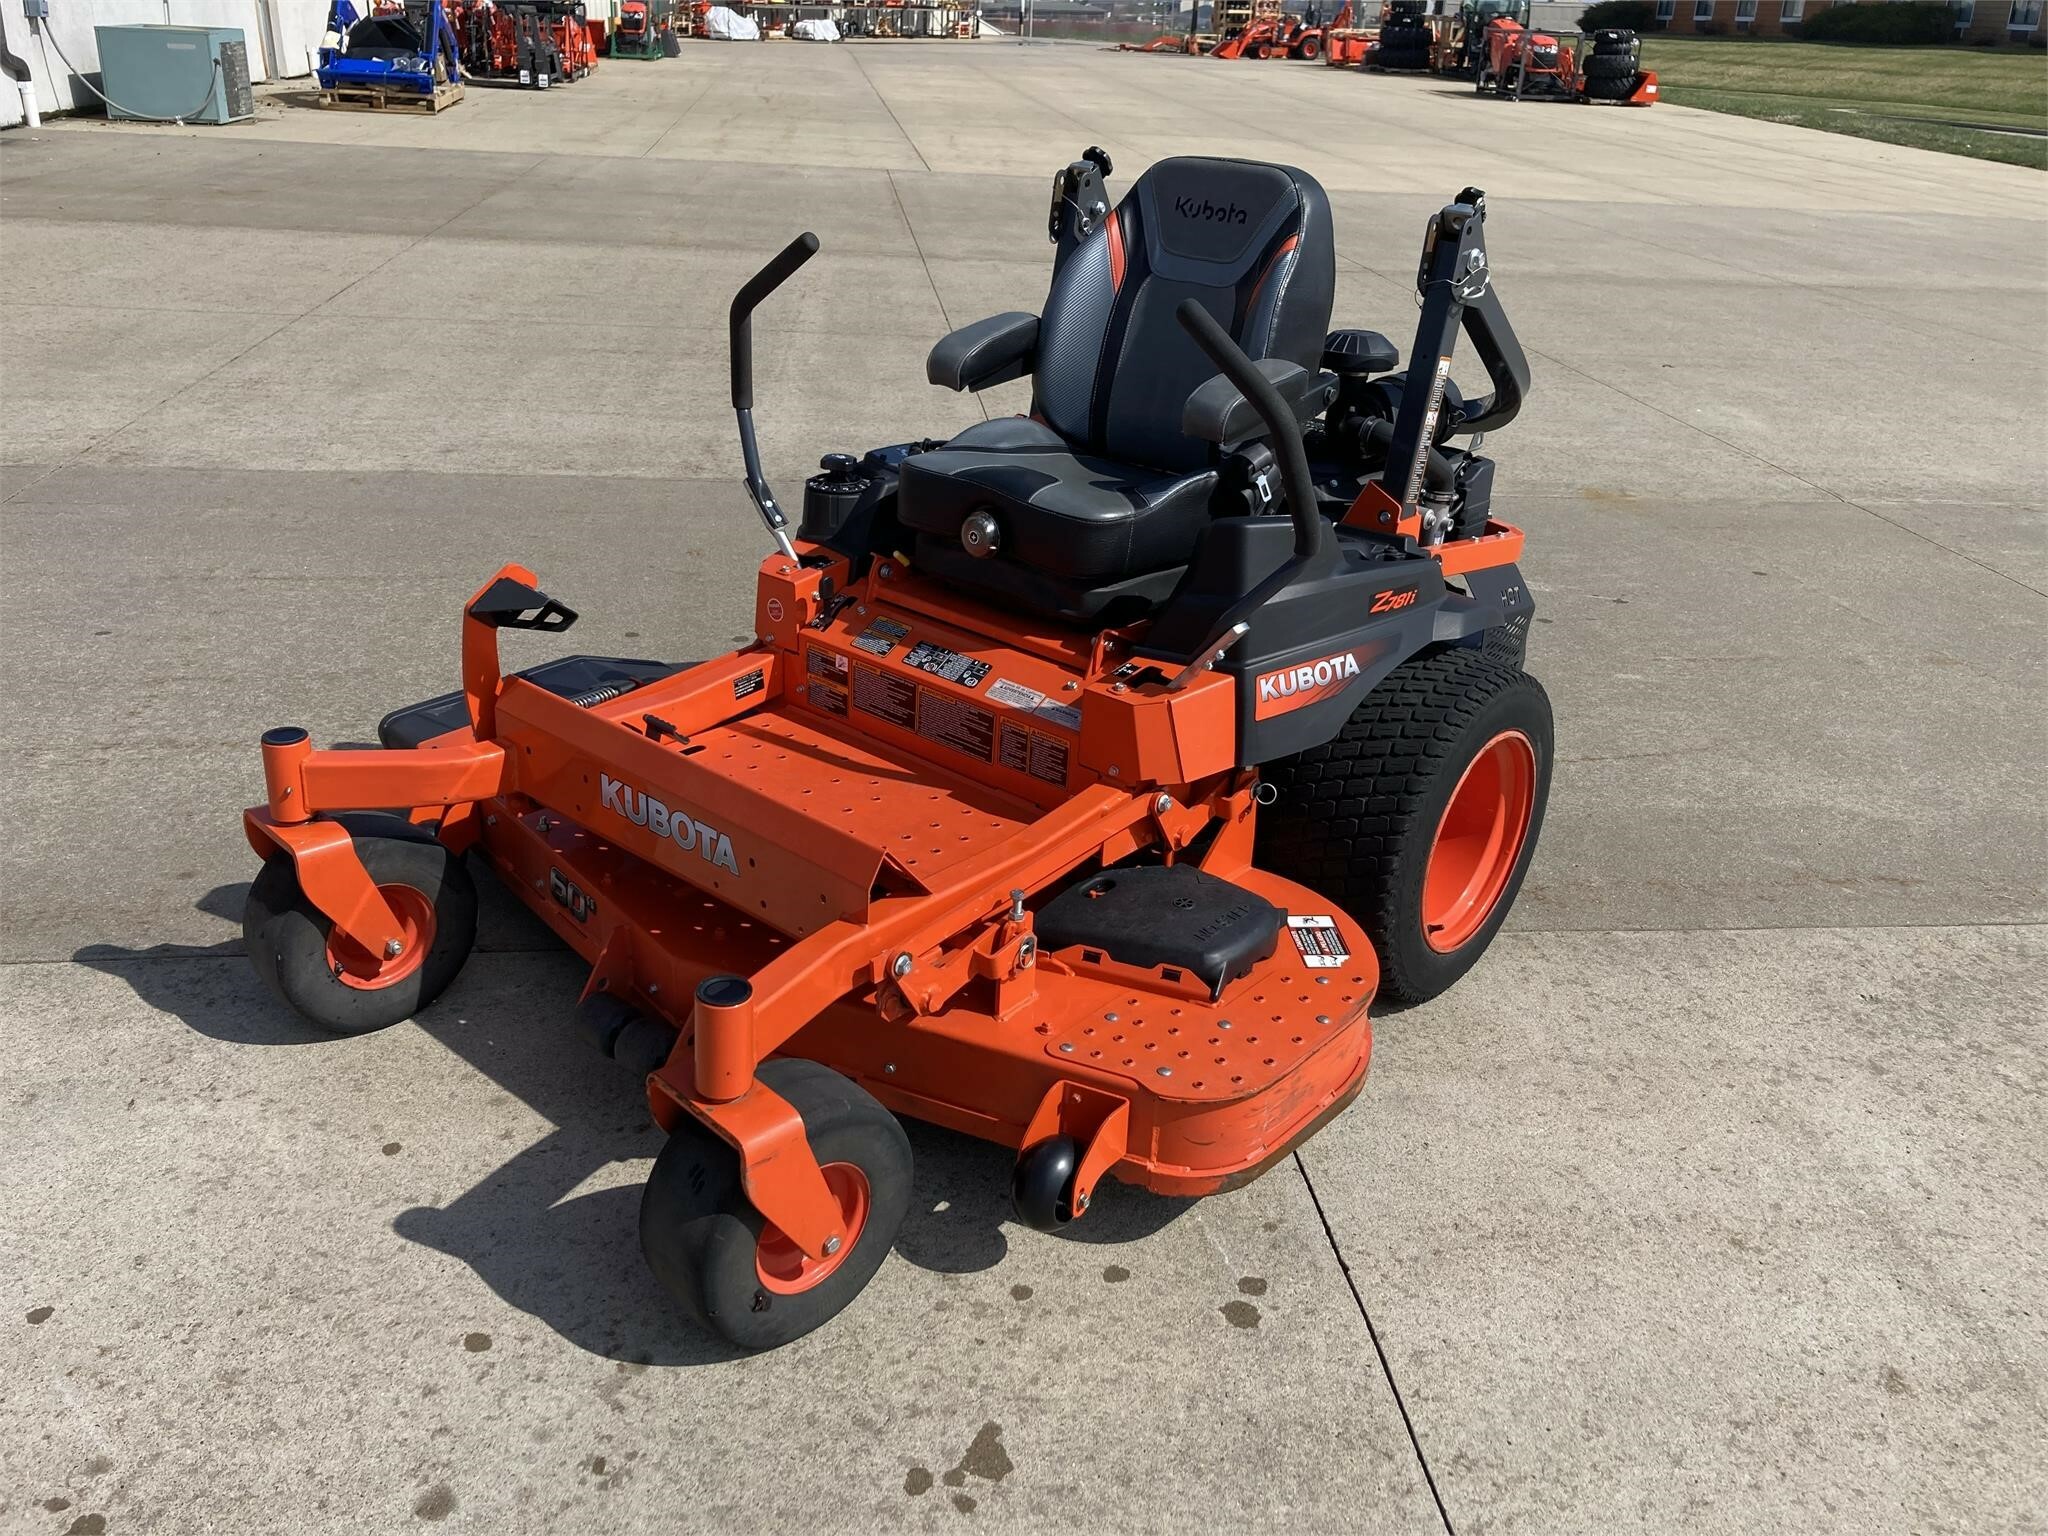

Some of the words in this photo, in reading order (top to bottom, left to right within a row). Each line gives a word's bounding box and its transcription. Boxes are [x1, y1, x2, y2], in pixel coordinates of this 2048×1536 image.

[1175, 196, 1248, 225] Kubota
[1369, 589, 1418, 614] Z781i
[1500, 586, 1521, 607] HOT
[1260, 653, 1360, 703] KUBOTA
[599, 773, 741, 876] KUBOTA
